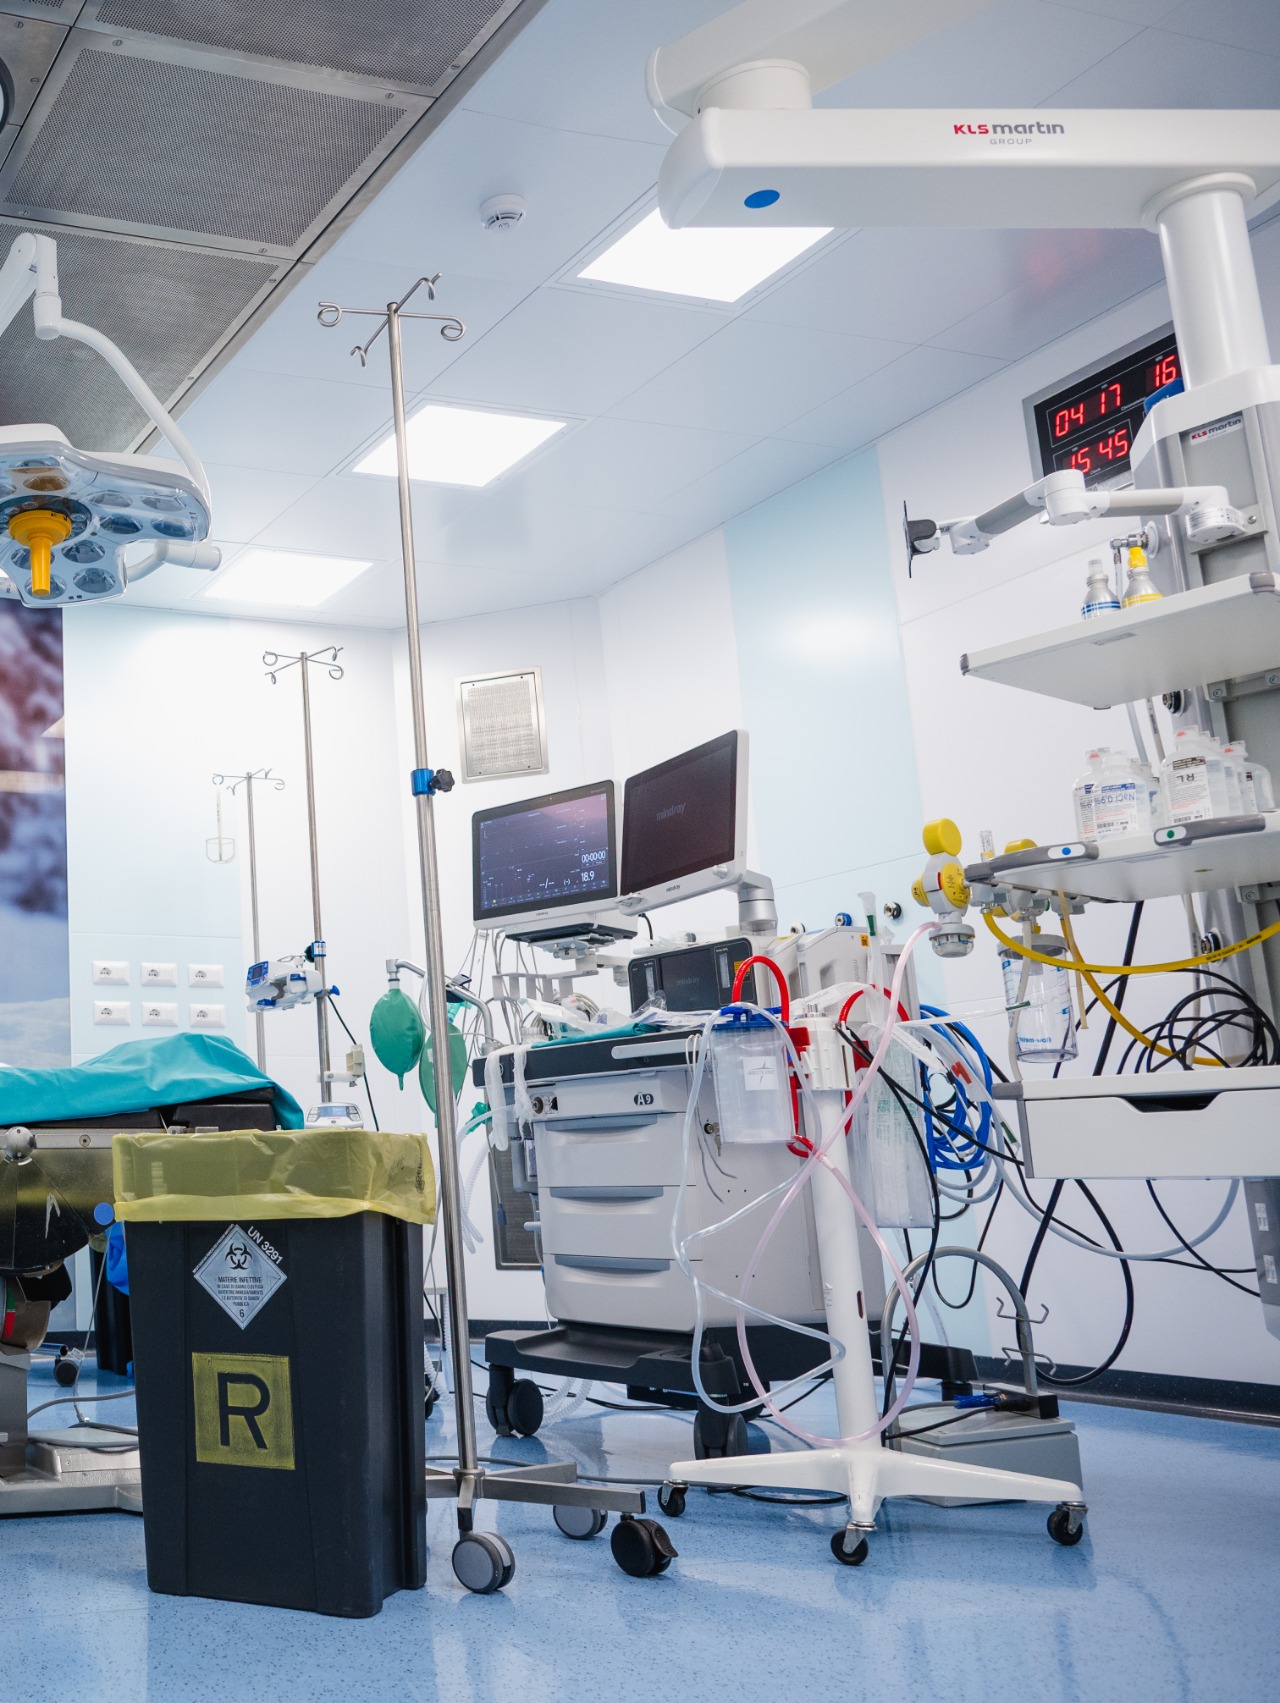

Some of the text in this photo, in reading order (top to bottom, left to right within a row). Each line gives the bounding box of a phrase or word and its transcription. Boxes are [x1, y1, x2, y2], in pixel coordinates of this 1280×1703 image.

[953, 121, 1065, 135] KLS martin
[1055, 402, 1084, 437] 04
[1099, 383, 1121, 414] 17
[1154, 355, 1177, 387] 16
[1191, 430, 1208, 440] KLS
[1209, 418, 1241, 434] martin
[1098, 429, 1129, 461] 45
[581, 870, 595, 882] 18.9
[247, 1226, 283, 1265] UN 3291
[239, 1309, 245, 1318] 6
[216, 1372, 271, 1450] R
